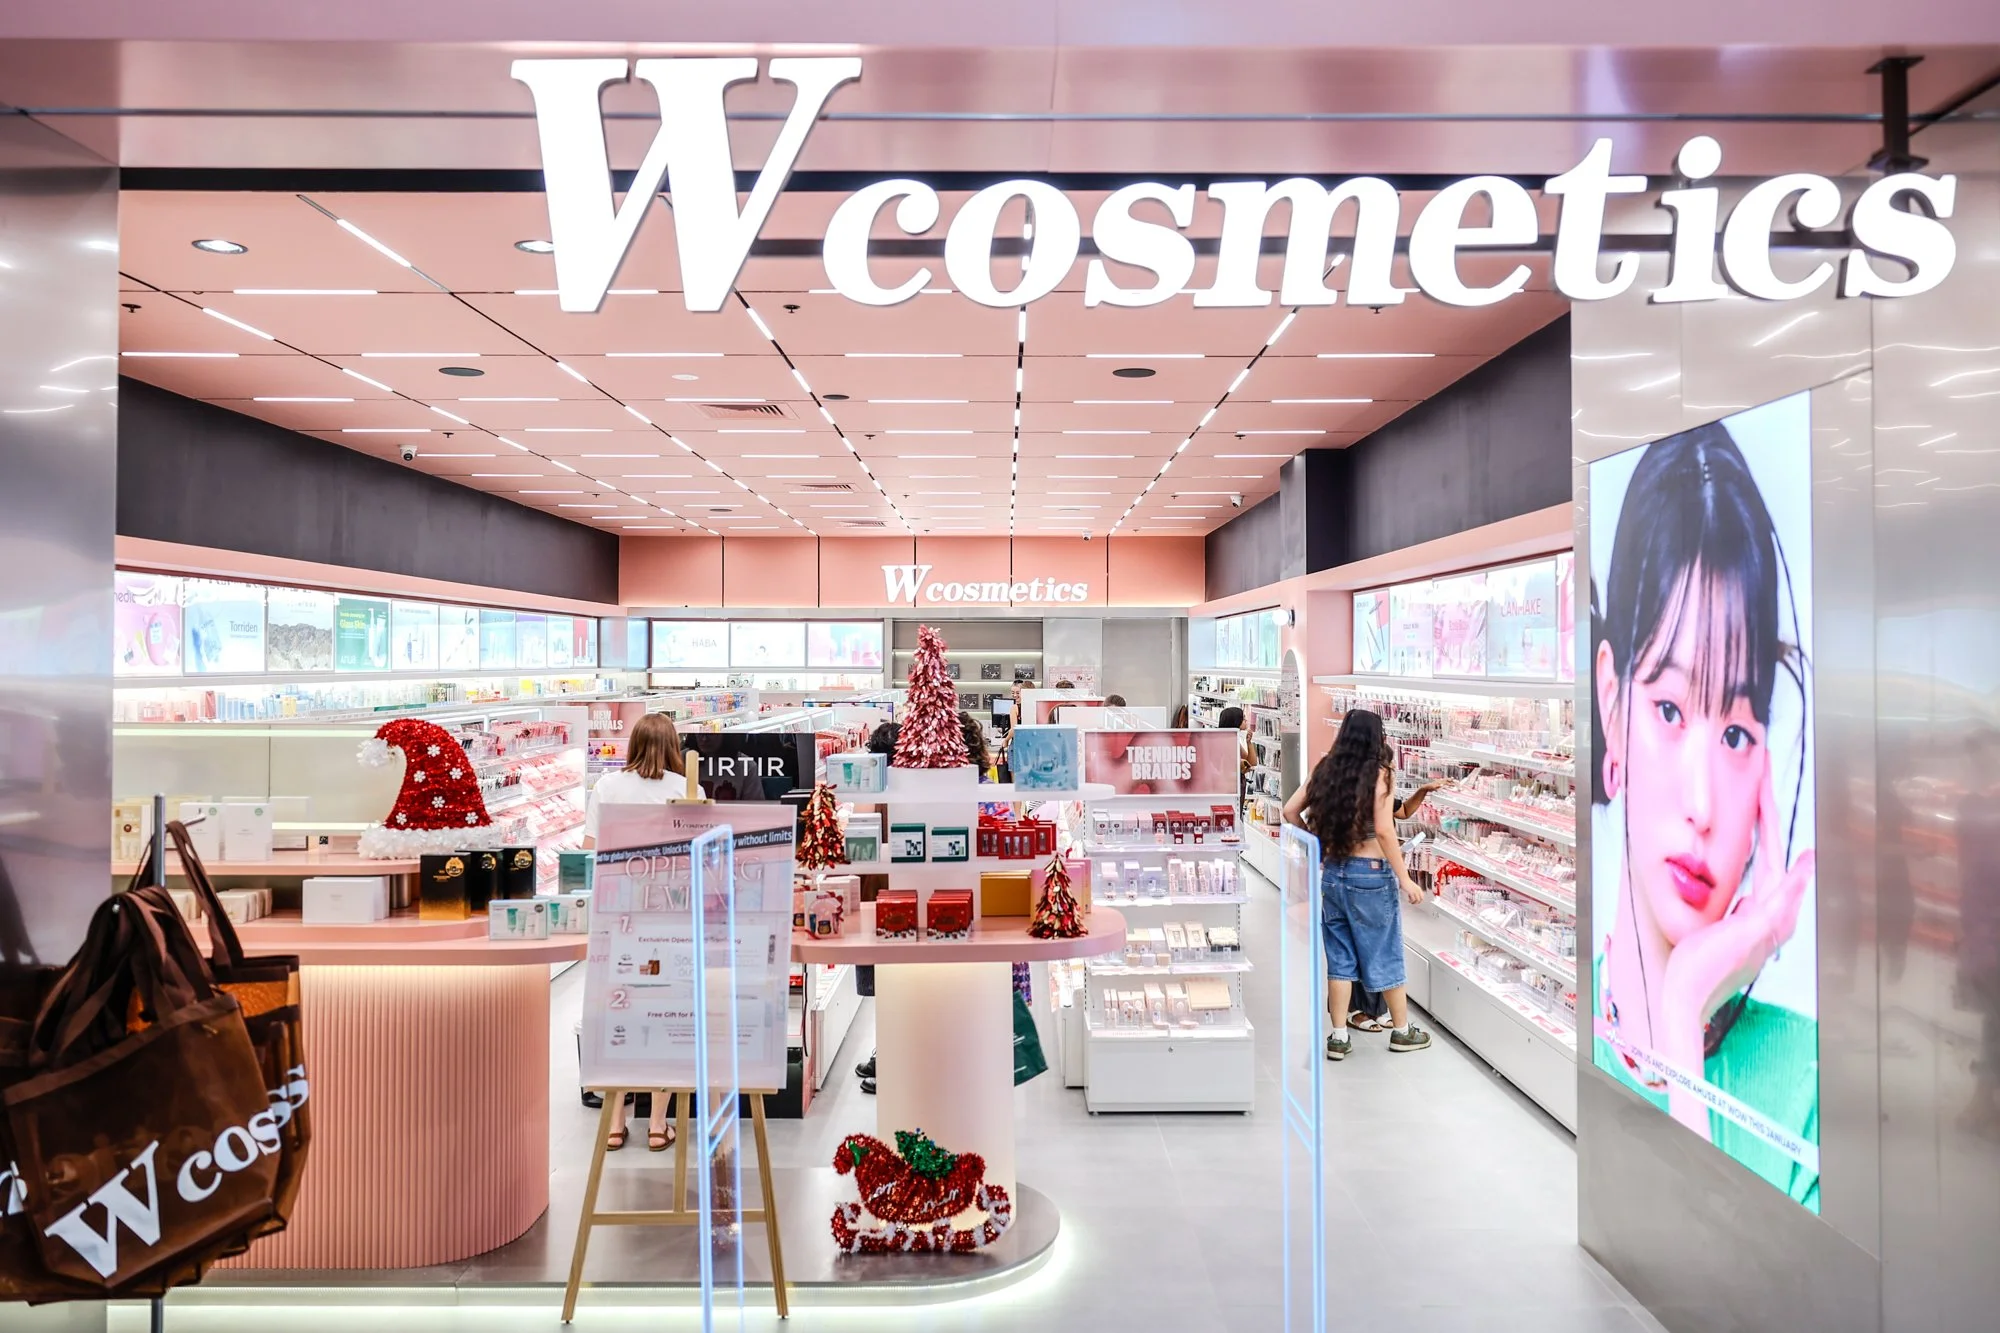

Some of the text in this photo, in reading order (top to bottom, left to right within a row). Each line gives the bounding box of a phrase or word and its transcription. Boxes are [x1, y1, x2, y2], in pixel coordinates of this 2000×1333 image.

[511, 56, 1957, 314] Wcosmetics
[881, 564, 1089, 603] Wcosmetics
[229, 620, 258, 633] Torriden
[692, 638, 717, 648] HABA
[593, 709, 612, 720] NEW
[588, 719, 624, 731] RRIVALS
[1126, 746, 1197, 763] TRENDING
[698, 756, 785, 777] IRTIR
[1131, 763, 1191, 780] BRANDS
[738, 833, 768, 846] without
[769, 830, 793, 843] limits
[638, 936, 670, 944] Exclusive
[1693, 1084, 1717, 1105] AMUSE
[1749, 1115, 1765, 1134] THIS
[1766, 1126, 1802, 1156] JANUARY
